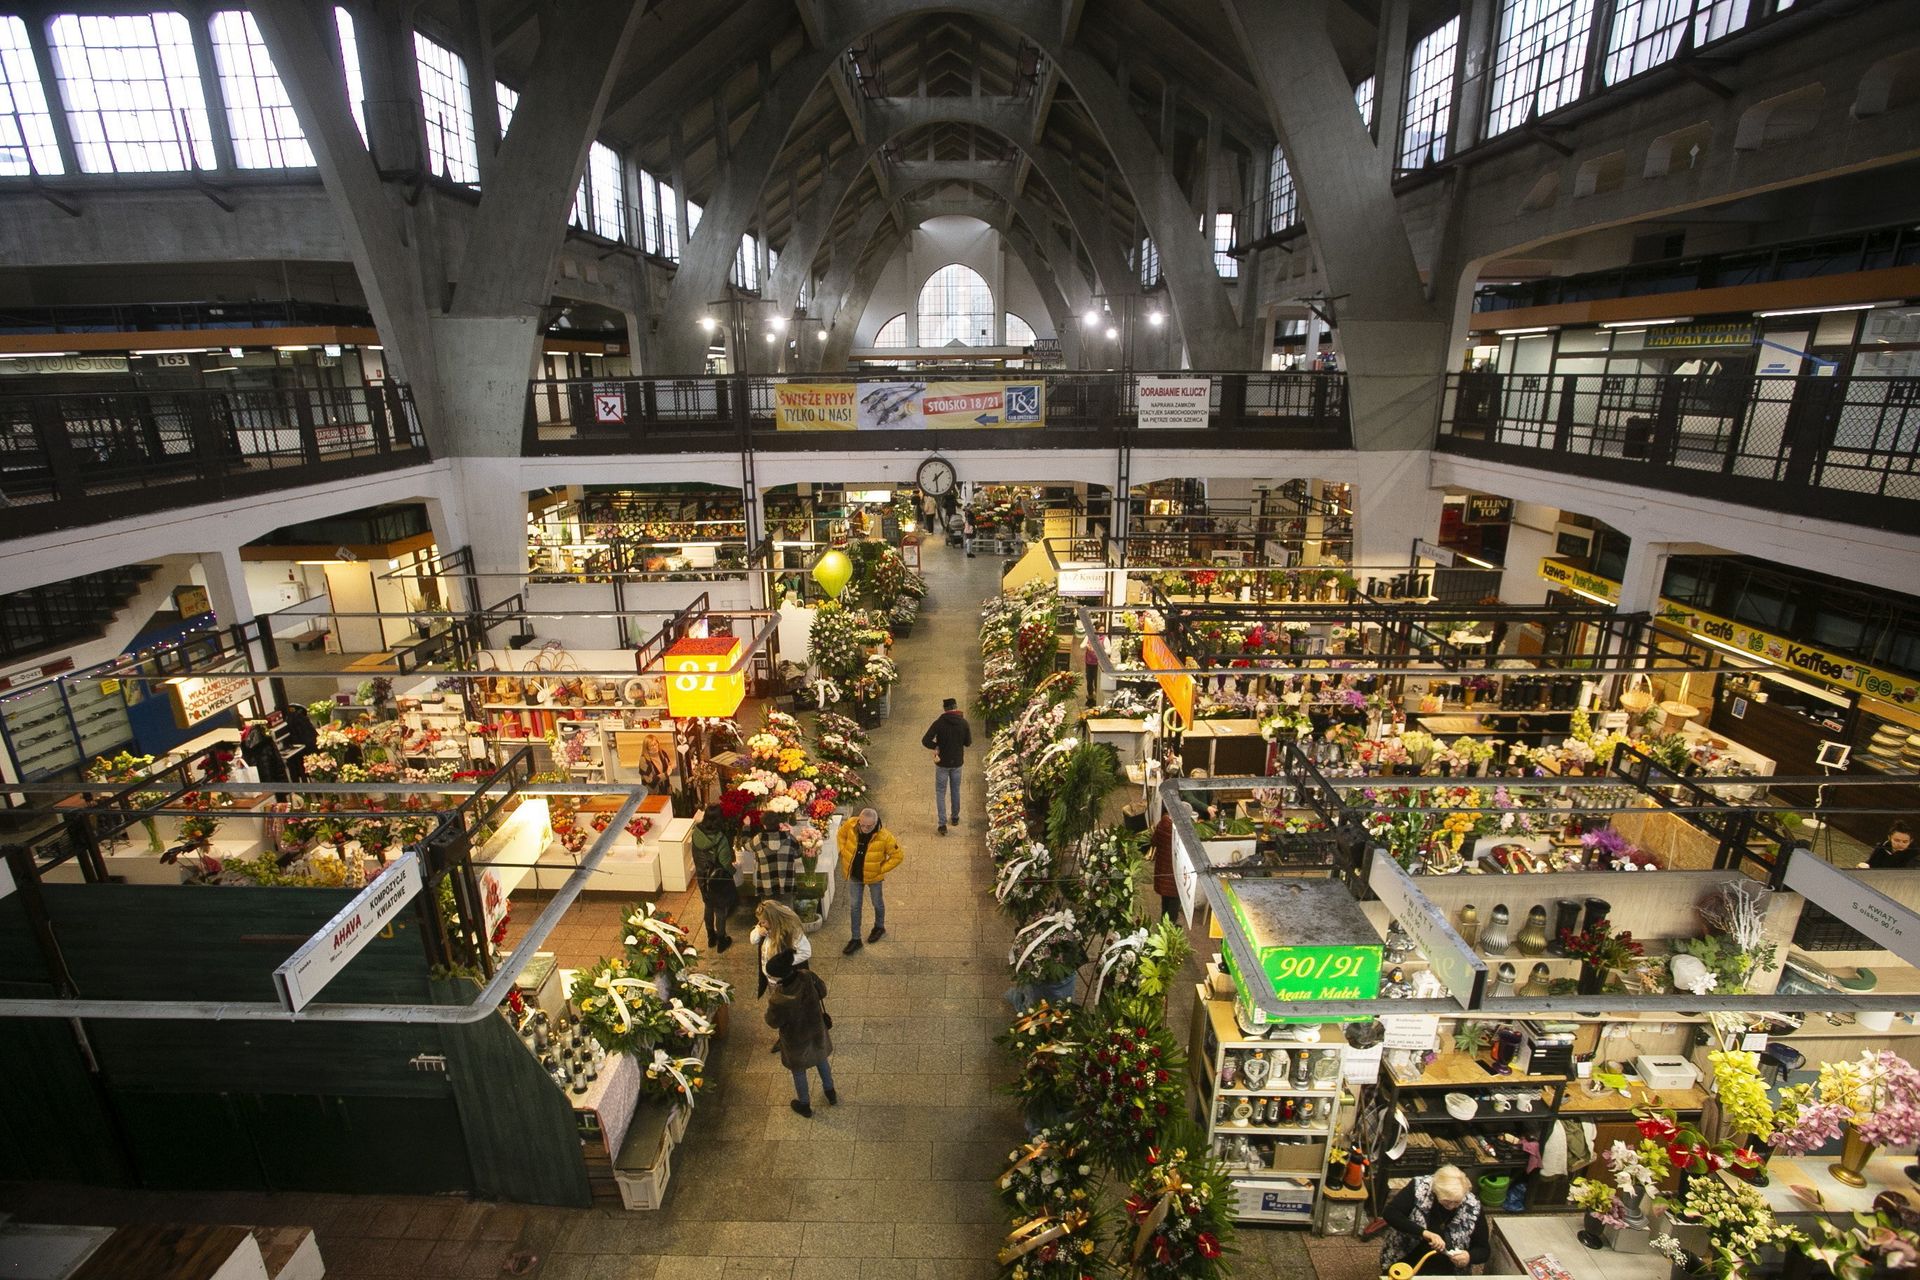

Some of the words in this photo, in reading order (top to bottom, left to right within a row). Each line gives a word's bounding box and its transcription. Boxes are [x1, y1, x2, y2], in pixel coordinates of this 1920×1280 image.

[159, 354, 187, 366] 163
[780, 390, 821, 406] ŚWIEŻE
[825, 392, 855, 406] RYBY
[1141, 387, 1180, 397] DORABIANIE
[1181, 387, 1207, 397] KLUCZY
[927, 399, 967, 413] STOISKO
[971, 396, 999, 410] 18/21
[784, 408, 815, 422] TYLKO
[818, 408, 825, 422] U
[829, 408, 852, 422] NAS!
[1473, 499, 1509, 509] PELLINI
[1480, 508, 1500, 517] TOP
[1543, 561, 1566, 581] kawa
[1703, 619, 1734, 642] café
[1785, 644, 1843, 680] Kaffee
[1855, 667, 1893, 696] Tee
[675, 660, 718, 692] 81
[370, 869, 407, 910] KOMPOZYCJE
[376, 886, 406, 919] KWIATOWE
[1868, 903, 1898, 925] KWIATY
[333, 914, 362, 950] AHAVA
[1275, 953, 1365, 980] 90/91
[1276, 988, 1313, 1002] Agata
